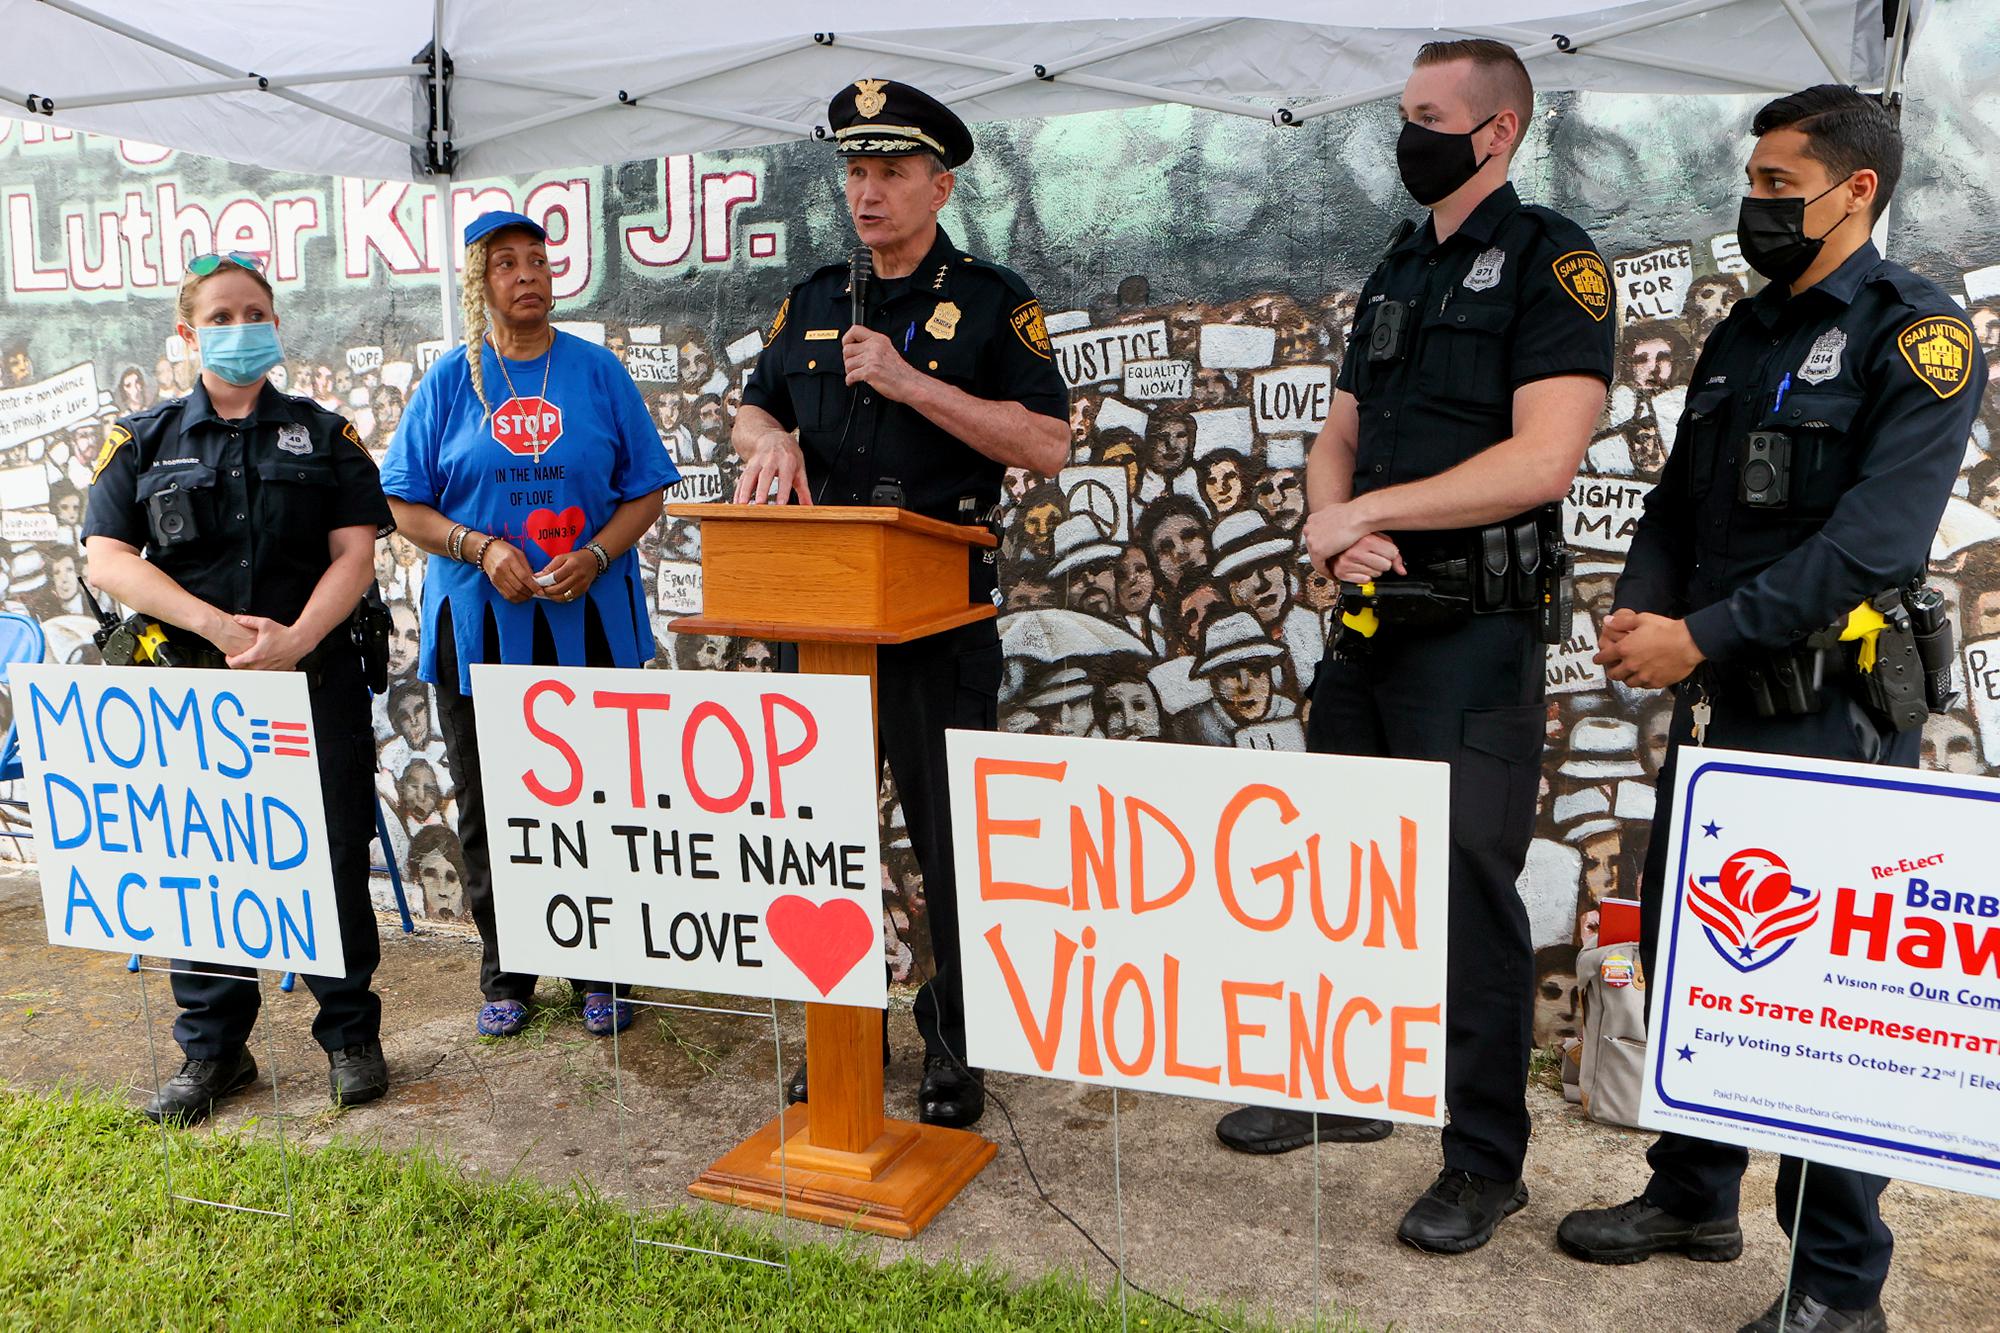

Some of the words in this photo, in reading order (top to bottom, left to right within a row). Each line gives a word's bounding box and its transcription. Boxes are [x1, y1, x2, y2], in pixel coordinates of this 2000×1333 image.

[8, 183, 318, 292] Luther
[625, 155, 777, 267] Jr.
[1475, 268, 1493, 276] 971
[1559, 259, 1578, 278] SAN
[1615, 249, 1690, 278] JUSTICE
[1582, 293, 1606, 307] POLICE
[1628, 276, 1673, 300] FOR
[1014, 310, 1029, 329] SAN
[1625, 297, 1673, 322] ALL
[1904, 326, 1927, 347] SAN
[1929, 323, 1969, 350] ANTONIO
[350, 352, 379, 367] HOPE
[628, 347, 672, 363] PEACE
[1054, 330, 1160, 385] USTICE
[1810, 354, 1833, 364] 1514
[1128, 363, 1191, 379] EQUALITY
[1925, 364, 1959, 382] POLICE
[1140, 379, 1183, 396] NOW!
[1261, 381, 1327, 421] LOVE
[496, 412, 556, 435] STOP
[495, 468, 506, 483] IN
[510, 467, 530, 482] THE
[534, 465, 565, 481] NAME
[510, 492, 523, 506] OF
[527, 491, 553, 505] LOVE
[1561, 484, 1646, 509] RIGHT
[537, 527, 560, 540] JOHN
[1559, 634, 1594, 656] ALL
[1545, 661, 1594, 687] UAL
[29, 681, 253, 779] MOMS
[521, 679, 818, 819] S.T.O.P.
[43, 773, 309, 870] DEMAND
[507, 818, 588, 869] IN
[611, 826, 720, 879] THE
[739, 834, 866, 890] NAME
[974, 757, 1195, 915] END
[1214, 783, 1418, 950] GUN
[546, 894, 613, 949] OF
[641, 903, 763, 967] LOVE
[1824, 973, 1833, 984] A
[1695, 1028, 1734, 1047] Early
[1738, 1034, 1791, 1057] Voting
[1795, 1044, 1843, 1064] Starts
[1848, 1053, 1916, 1078] October
[1713, 1089, 1732, 1100] Paid
[1734, 1093, 1749, 1103] Pol
[1750, 1096, 1763, 1106] Ad
[1764, 1098, 1777, 1110] by
[1777, 1101, 1794, 1112] the
[1795, 1104, 1830, 1119] Barbara
